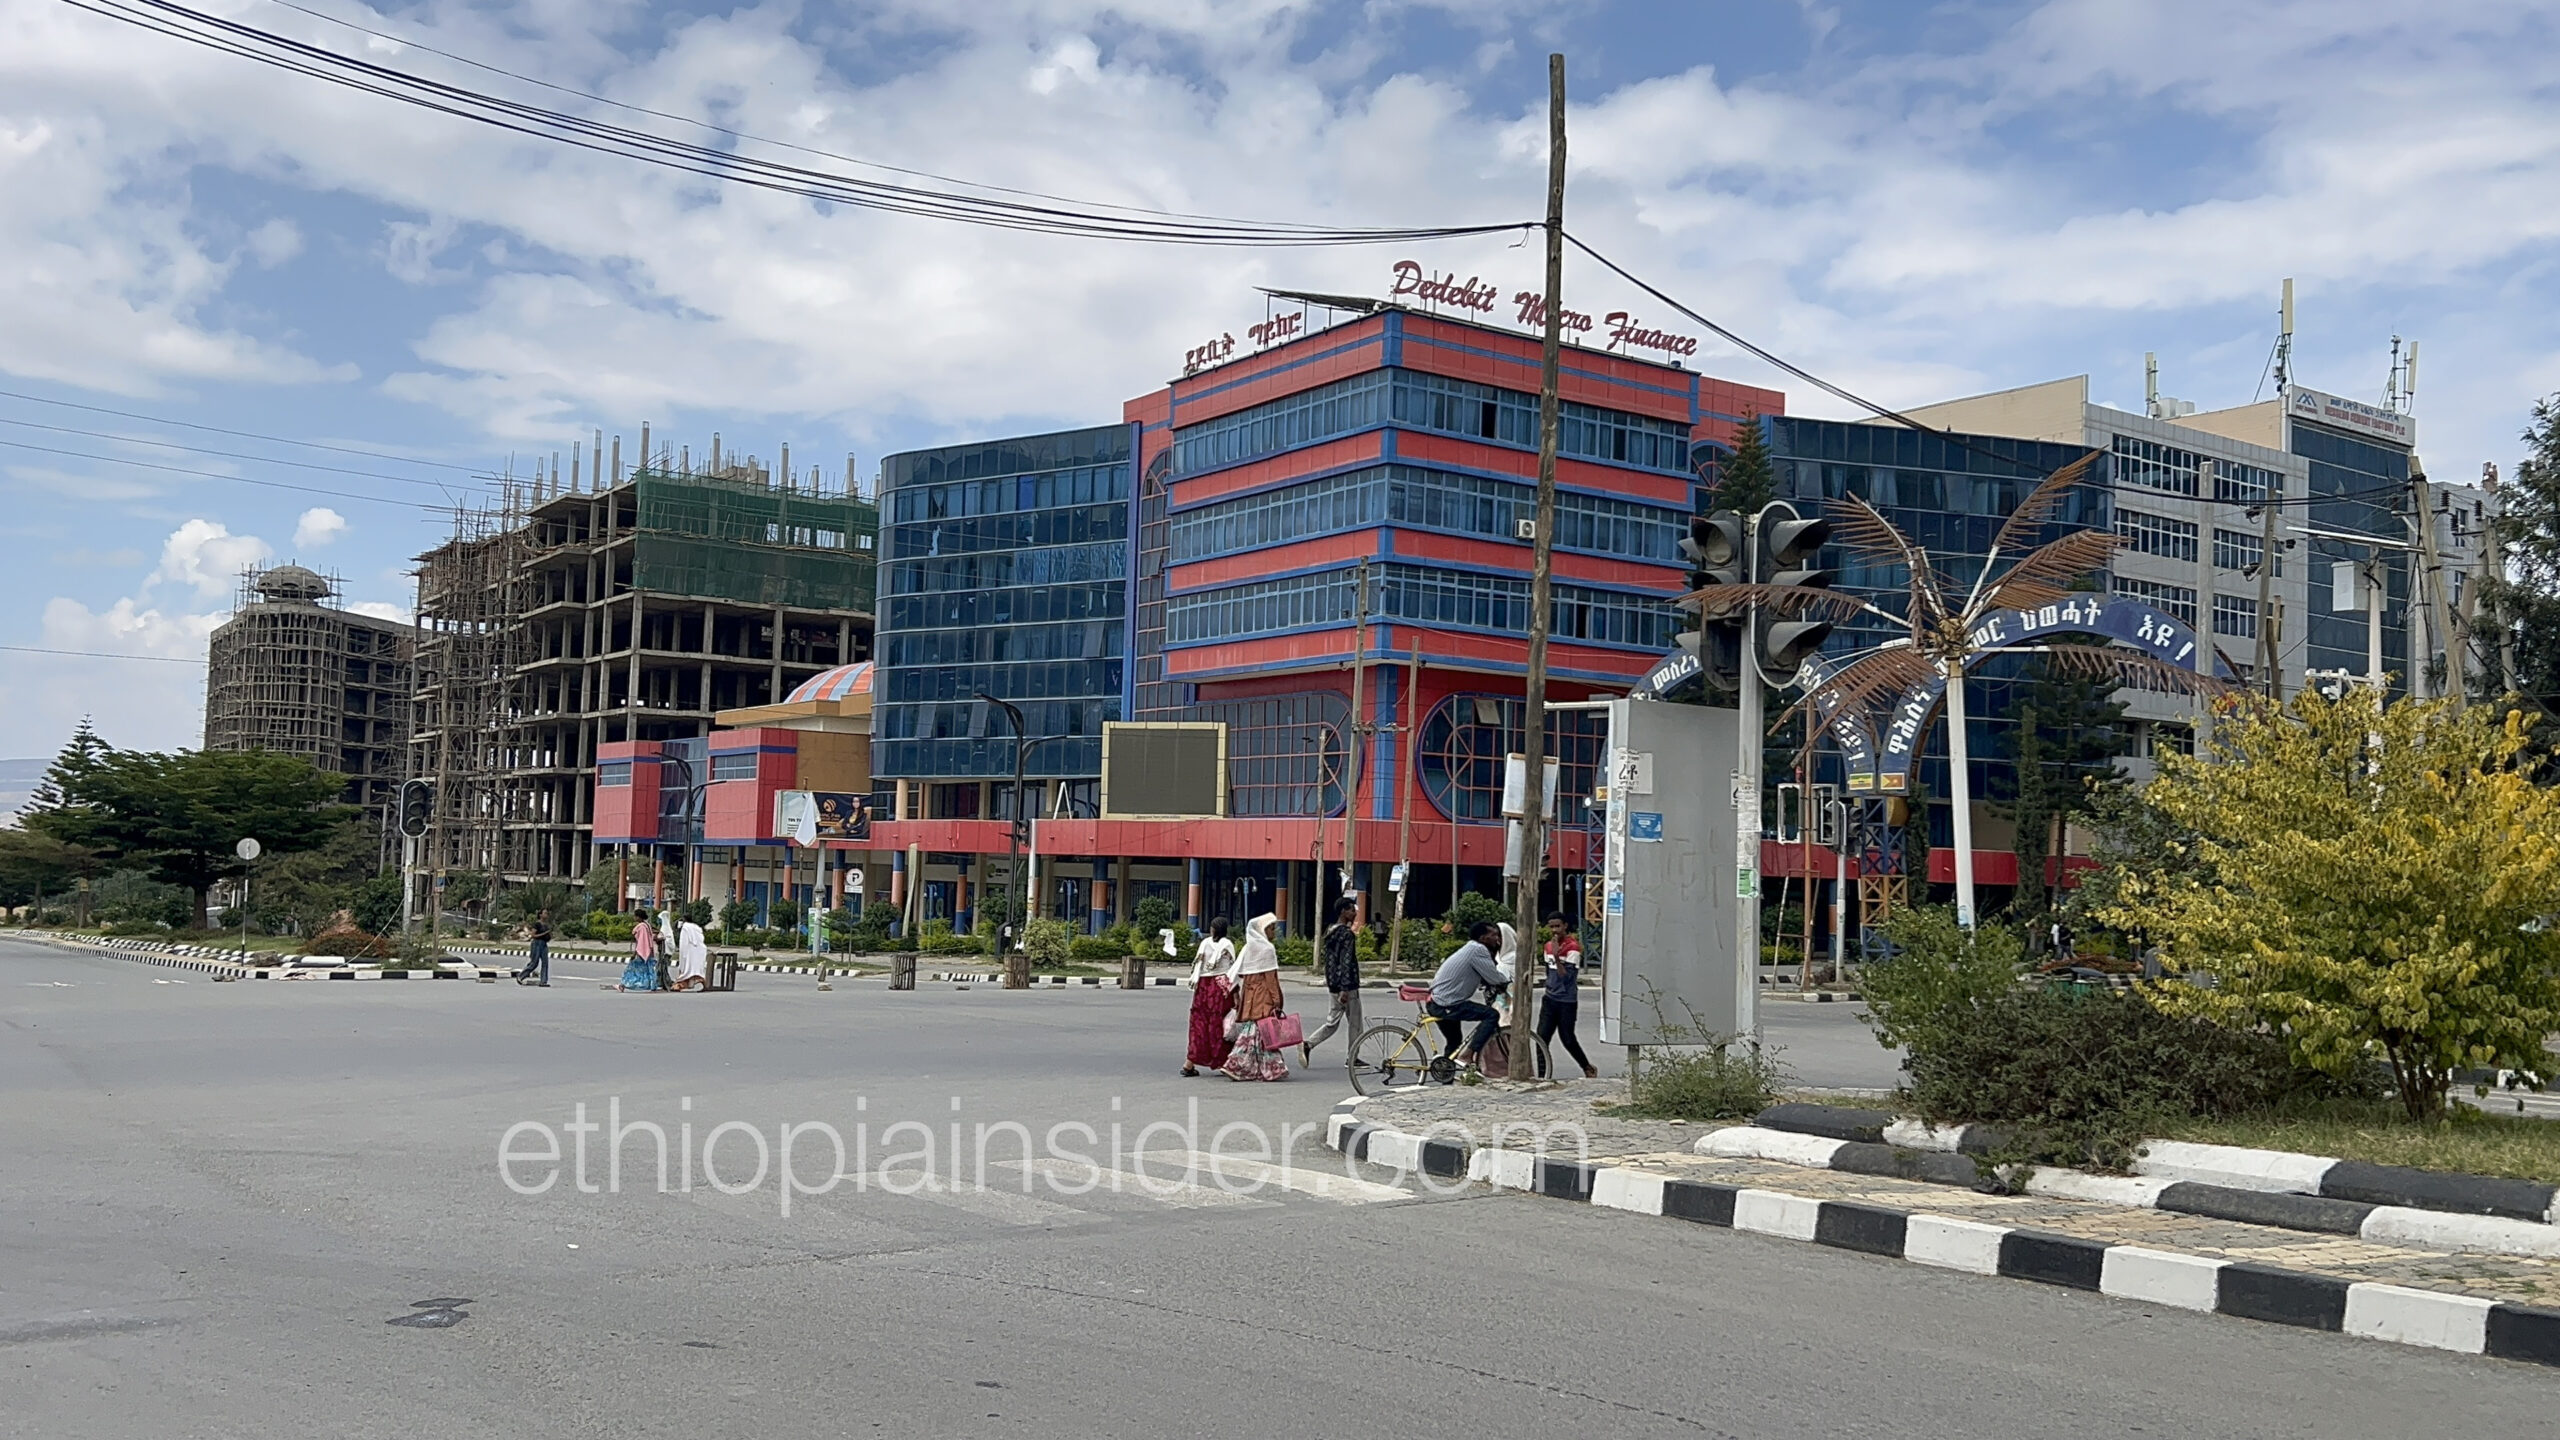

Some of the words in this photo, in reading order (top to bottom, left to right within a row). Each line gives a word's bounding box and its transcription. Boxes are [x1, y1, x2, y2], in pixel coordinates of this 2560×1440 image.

[1393, 260, 1497, 312] Dedebit
[1513, 291, 1593, 333] Mcro
[1604, 311, 1697, 356] Finance
